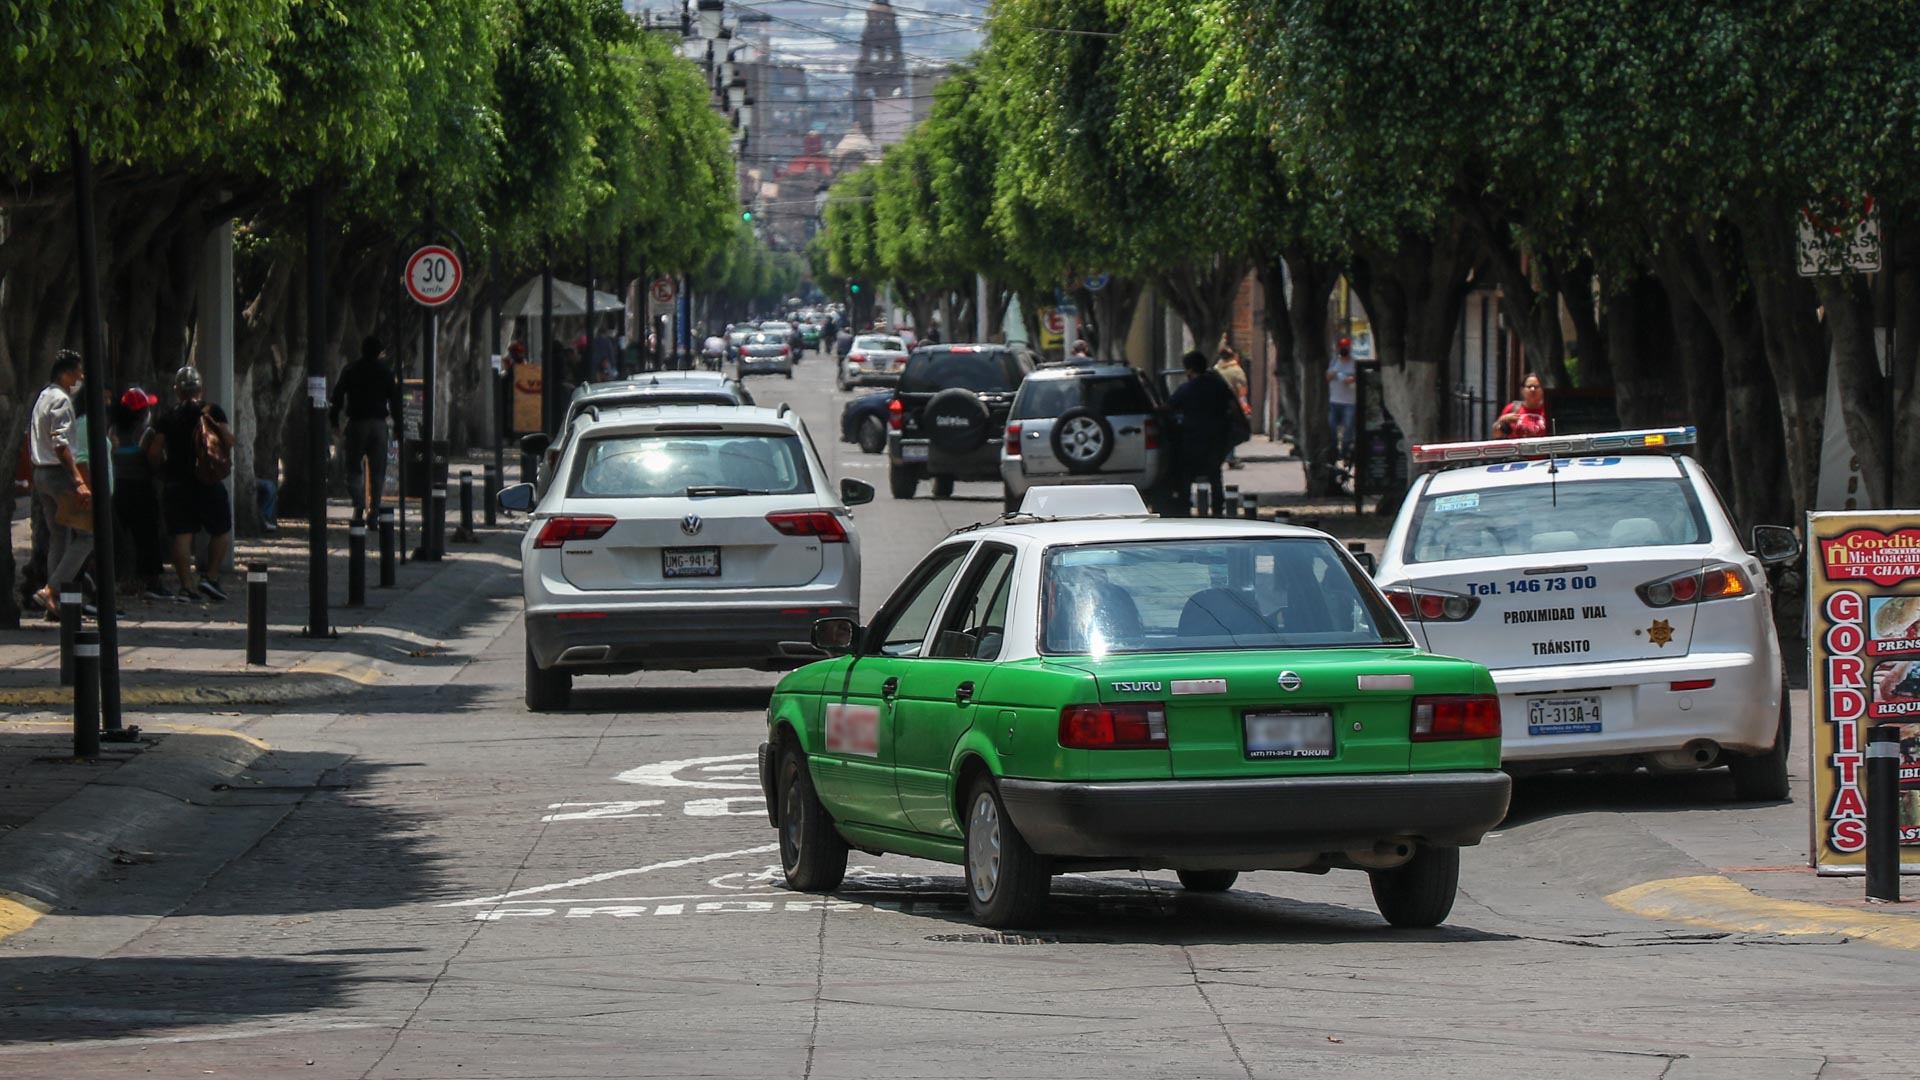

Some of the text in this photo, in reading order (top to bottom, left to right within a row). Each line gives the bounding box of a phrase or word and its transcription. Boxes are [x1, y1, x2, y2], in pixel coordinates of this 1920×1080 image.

[423, 258, 446, 283] 30
[421, 285, 443, 293] km/h
[1467, 575, 1597, 596] Tel. 146 73 00
[1504, 605, 1607, 624] PROXIMIDAD VIAL
[1532, 638, 1590, 655] TRÁNSITO
[1111, 681, 1162, 692] TSURU
[1530, 706, 1600, 725] GT-313A-4
[1827, 591, 1866, 853] GORDITAS
